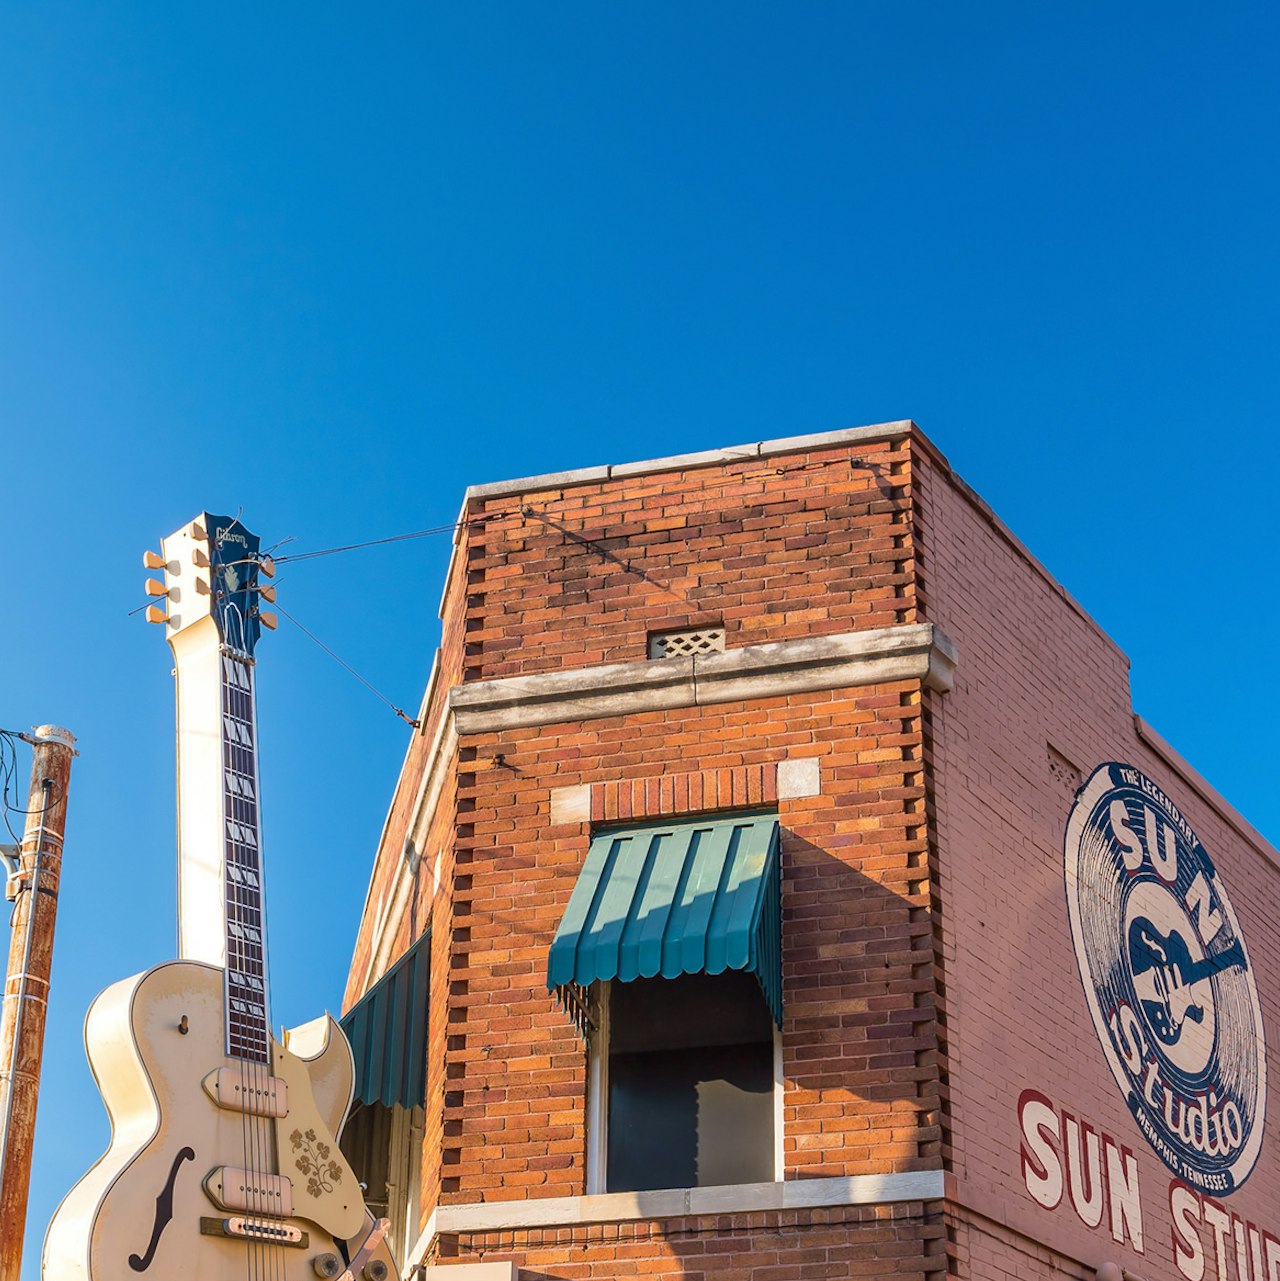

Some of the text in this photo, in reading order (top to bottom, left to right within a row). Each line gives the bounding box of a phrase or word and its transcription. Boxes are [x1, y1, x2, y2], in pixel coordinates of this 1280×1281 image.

[1108, 799, 1224, 947] SUN
[1119, 768, 1201, 848] THE LEGENDARY
[1108, 1001, 1244, 1158] Studio
[1018, 1090, 1144, 1255] SUN
[1182, 1162, 1229, 1191] TENNESSEE
